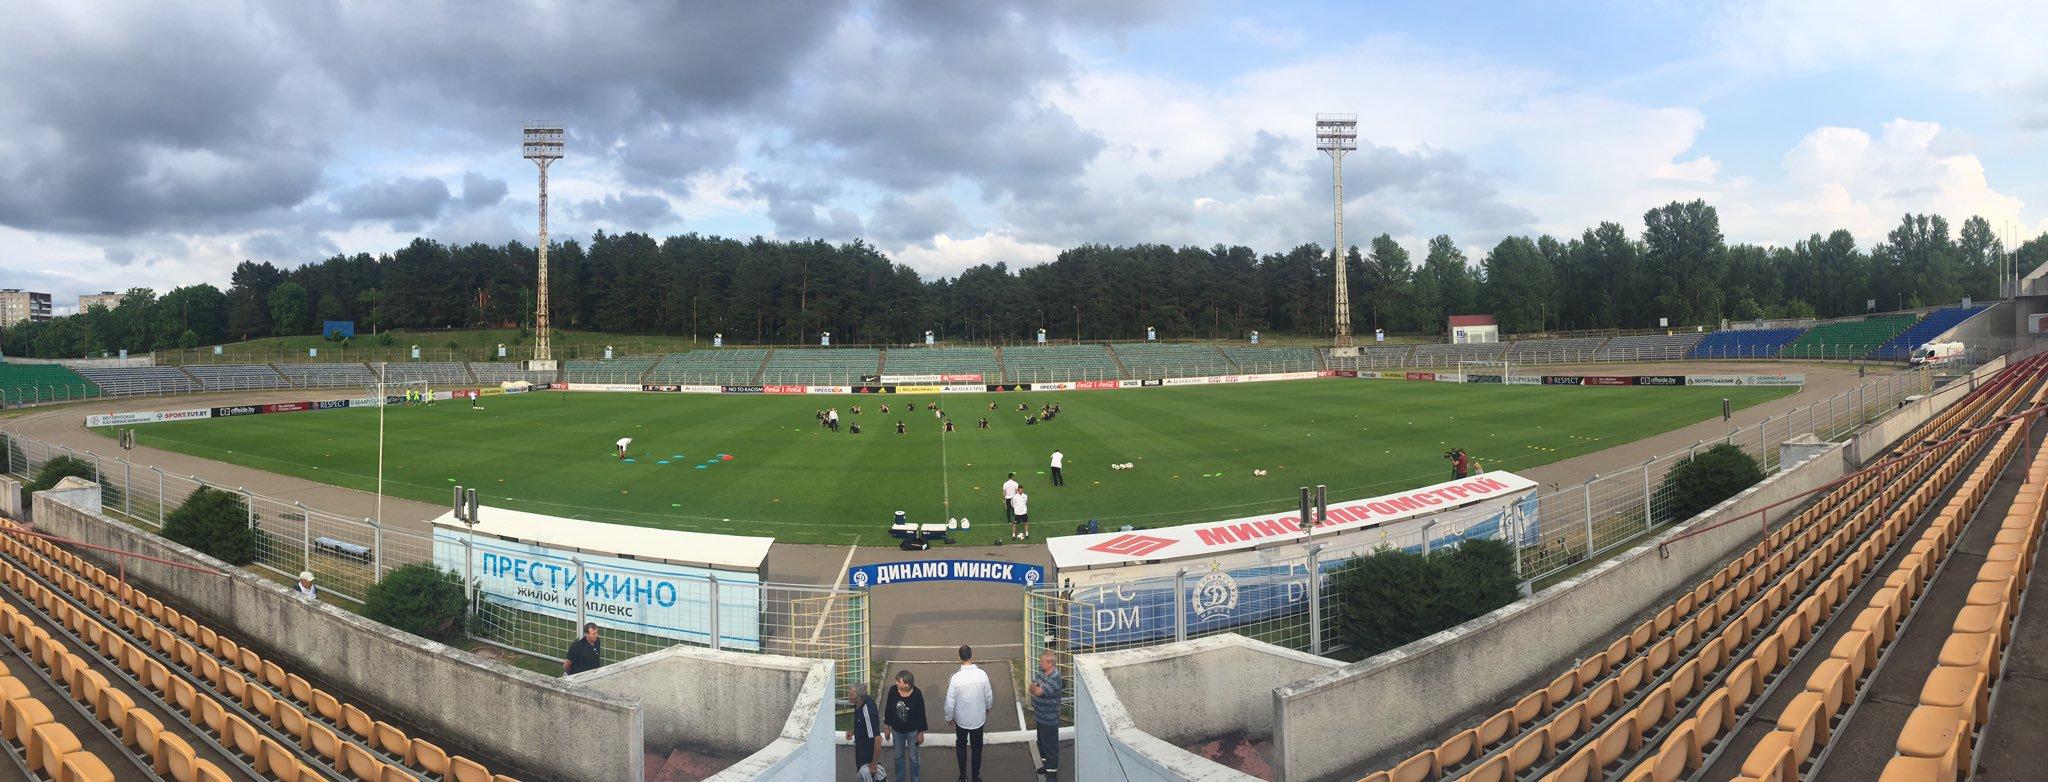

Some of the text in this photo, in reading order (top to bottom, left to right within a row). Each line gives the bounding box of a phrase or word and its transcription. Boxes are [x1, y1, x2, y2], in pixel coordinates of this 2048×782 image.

[164, 410, 208, 419] SPORT.TUT.BY
[320, 400, 346, 408] RESPECT
[483, 552, 677, 608] ПРЕСТИЖИНО
[876, 561, 1014, 584] ДИНАМО МИНСК
[1099, 581, 1137, 604] FC
[1097, 606, 1140, 632] DM
